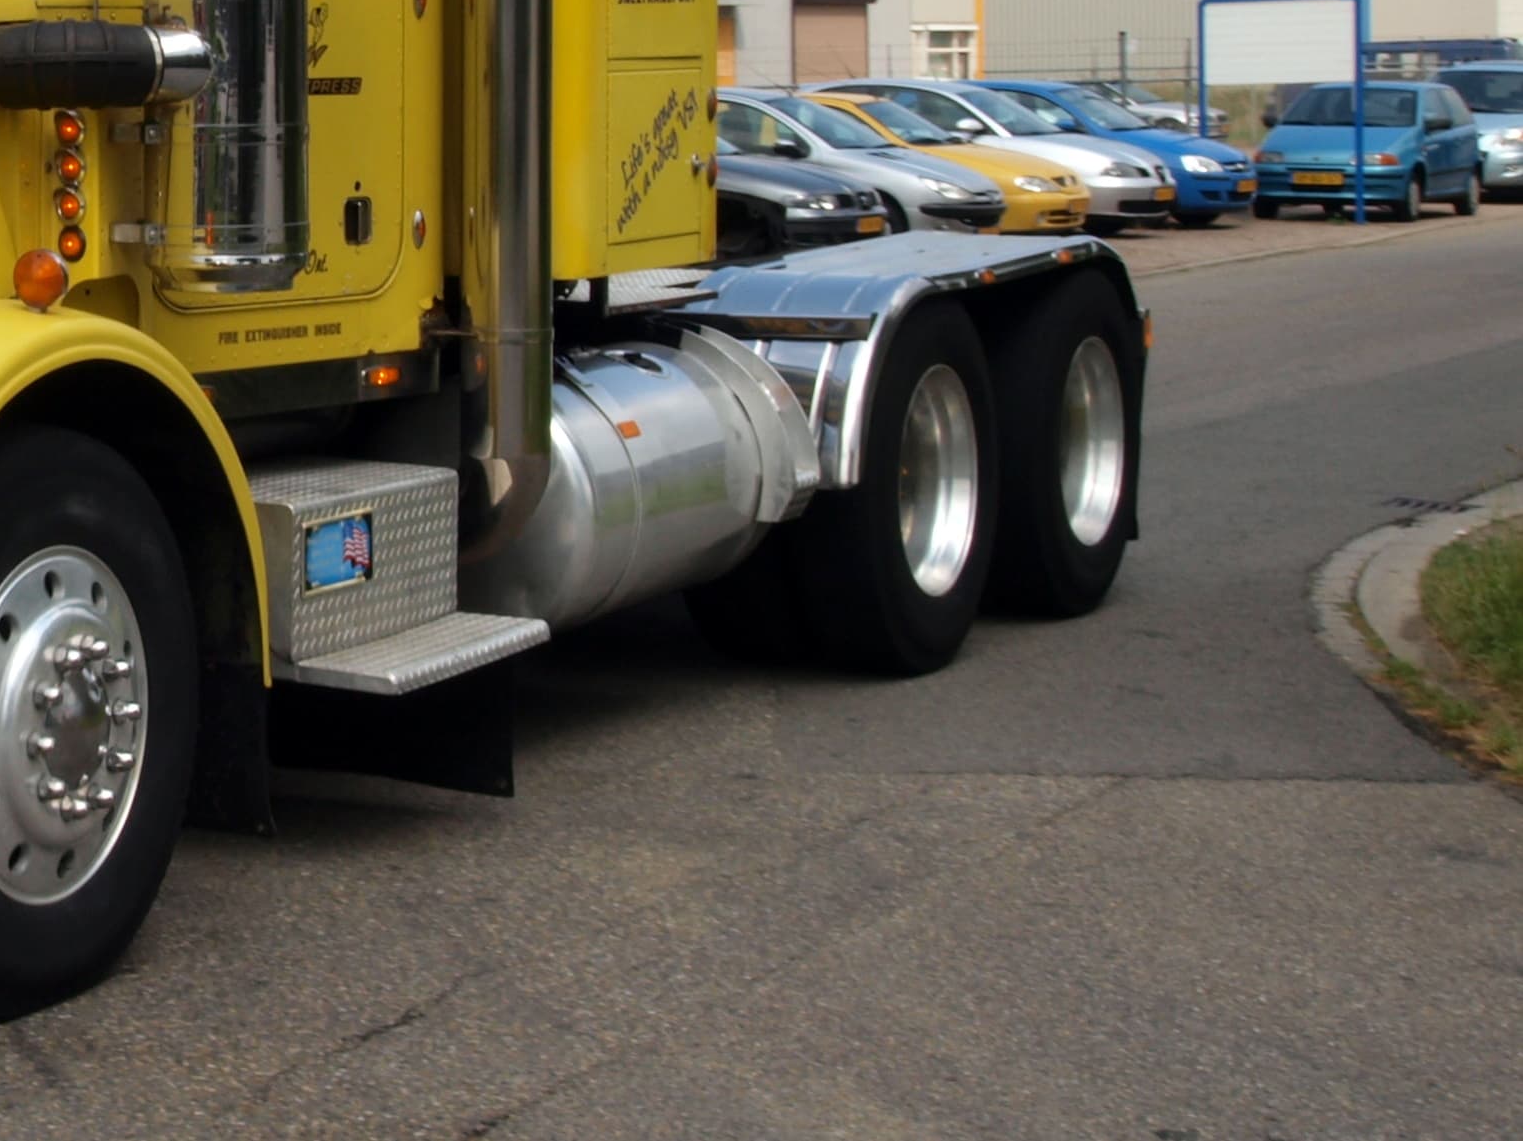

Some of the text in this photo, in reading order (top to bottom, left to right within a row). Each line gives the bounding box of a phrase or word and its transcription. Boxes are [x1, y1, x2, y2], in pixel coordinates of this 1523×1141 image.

[219, 322, 342, 345] FIRE EXTINGUISHER INSIDE
